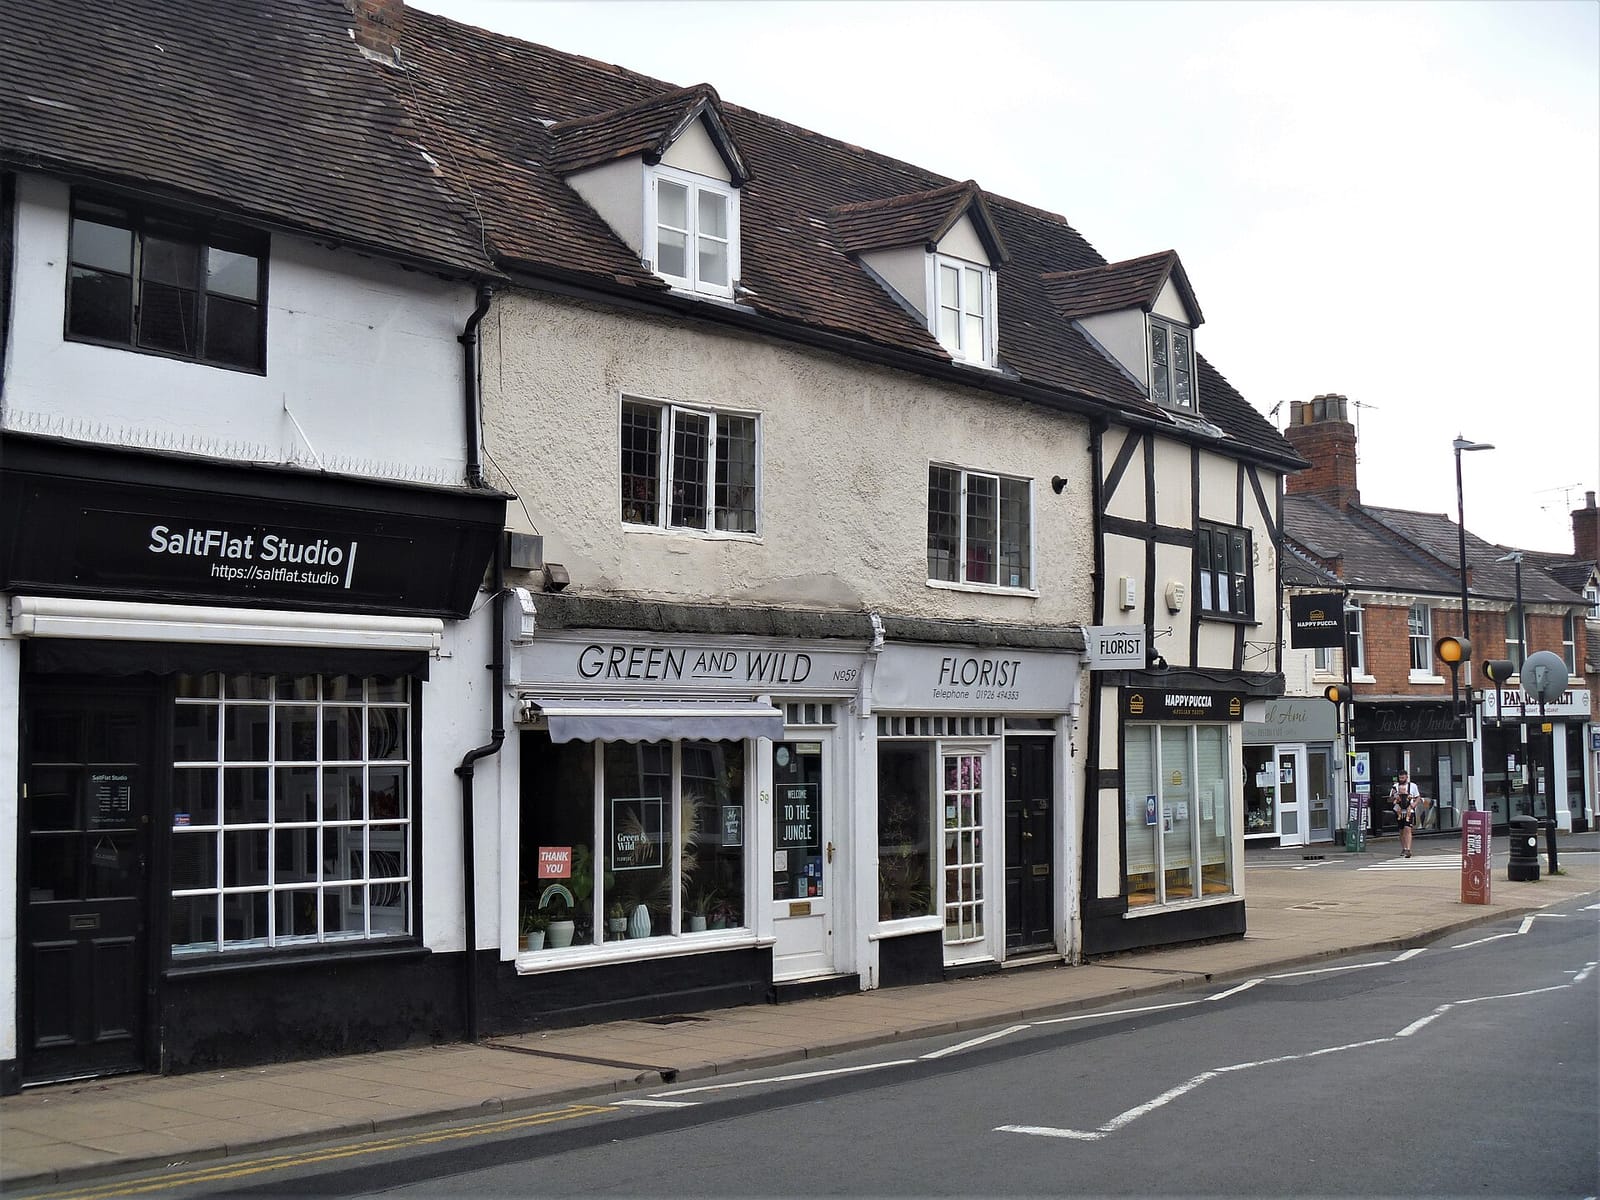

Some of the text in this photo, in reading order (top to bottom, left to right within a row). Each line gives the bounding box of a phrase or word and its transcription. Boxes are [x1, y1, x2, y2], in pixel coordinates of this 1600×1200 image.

[149, 525, 343, 566] SaltFlat Studio
[211, 563, 339, 585] https://saltflat.studio
[1100, 639, 1141, 655] FLORIST
[577, 644, 812, 684] GREEN AND WILD
[938, 657, 1022, 688] FLORIST
[932, 688, 1019, 700] Telephone 01926 494353
[1165, 694, 1212, 708] HAPPY PUCCIA
[784, 804, 811, 820] TO THE
[617, 832, 640, 843] Green
[783, 824, 812, 841] JUNGLE
[617, 841, 635, 851] Wild
[541, 851, 569, 862] THANK
[545, 864, 564, 873] YOU
